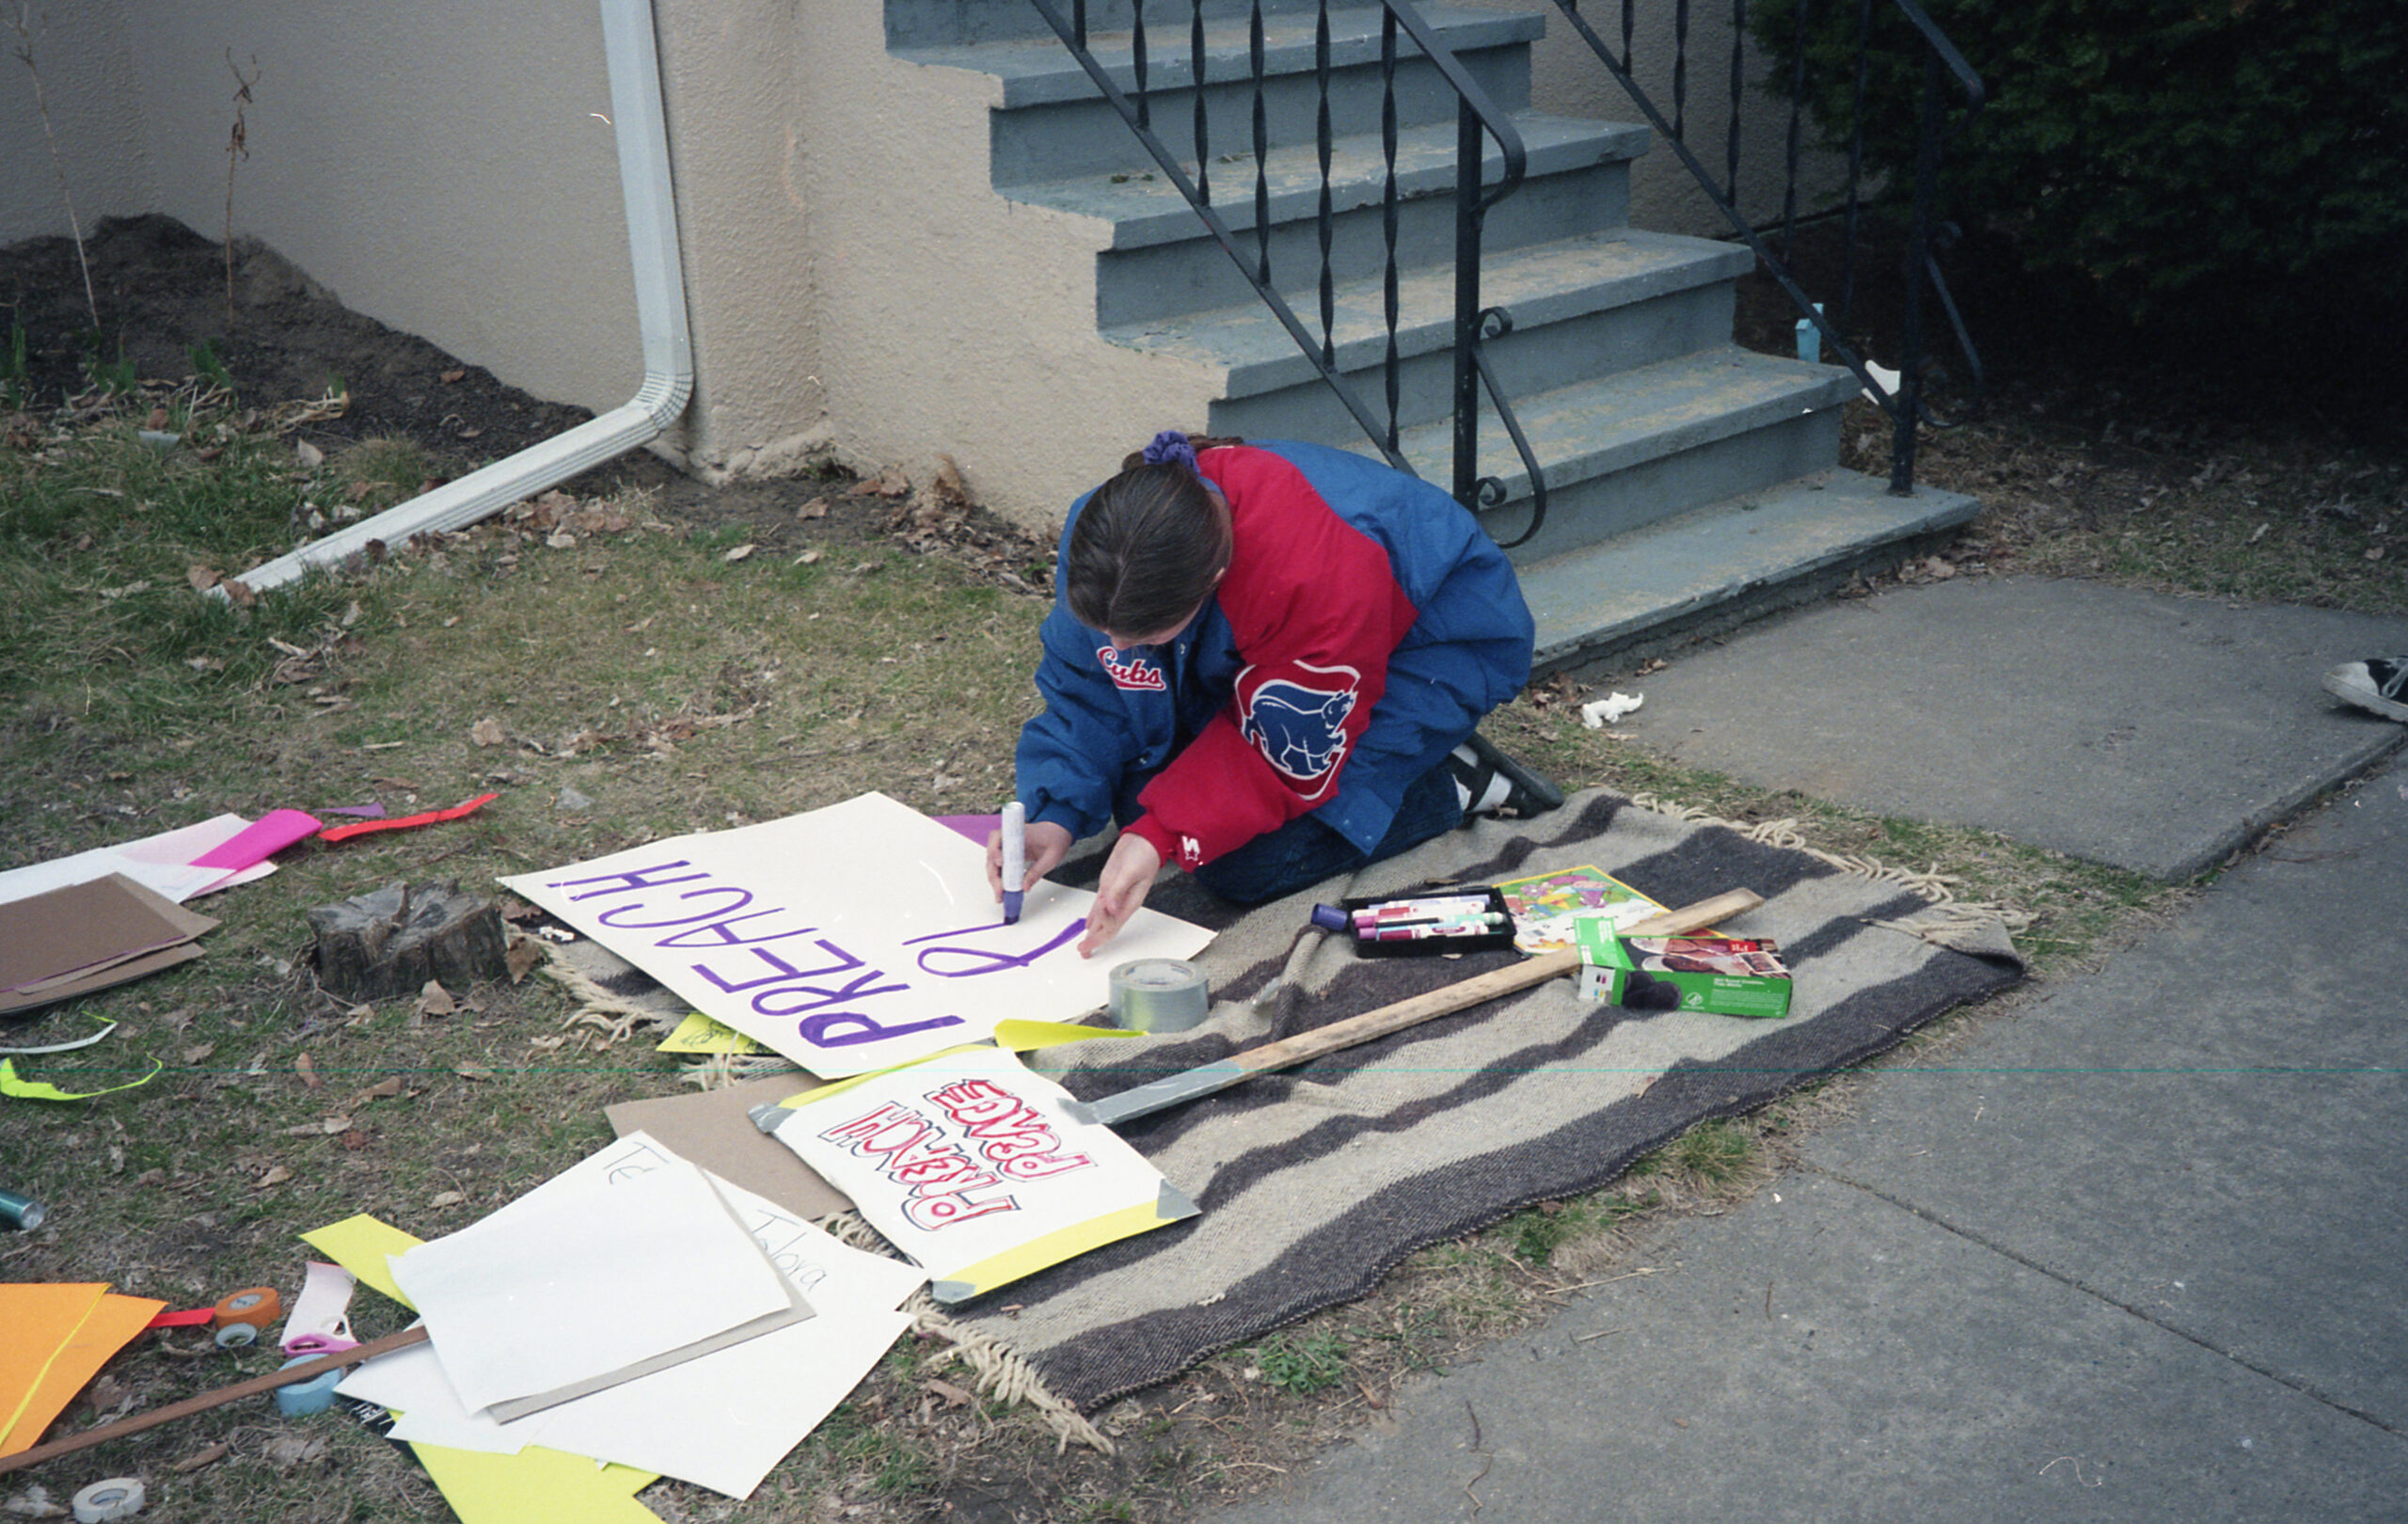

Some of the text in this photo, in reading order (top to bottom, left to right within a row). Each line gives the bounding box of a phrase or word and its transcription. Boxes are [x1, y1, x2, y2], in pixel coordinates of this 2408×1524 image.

[1097, 646, 1166, 691] Cubs
[547, 860, 966, 1049] PREACH
[817, 1100, 1022, 1232] PREACH
[923, 1078, 1099, 1183] PEACE
